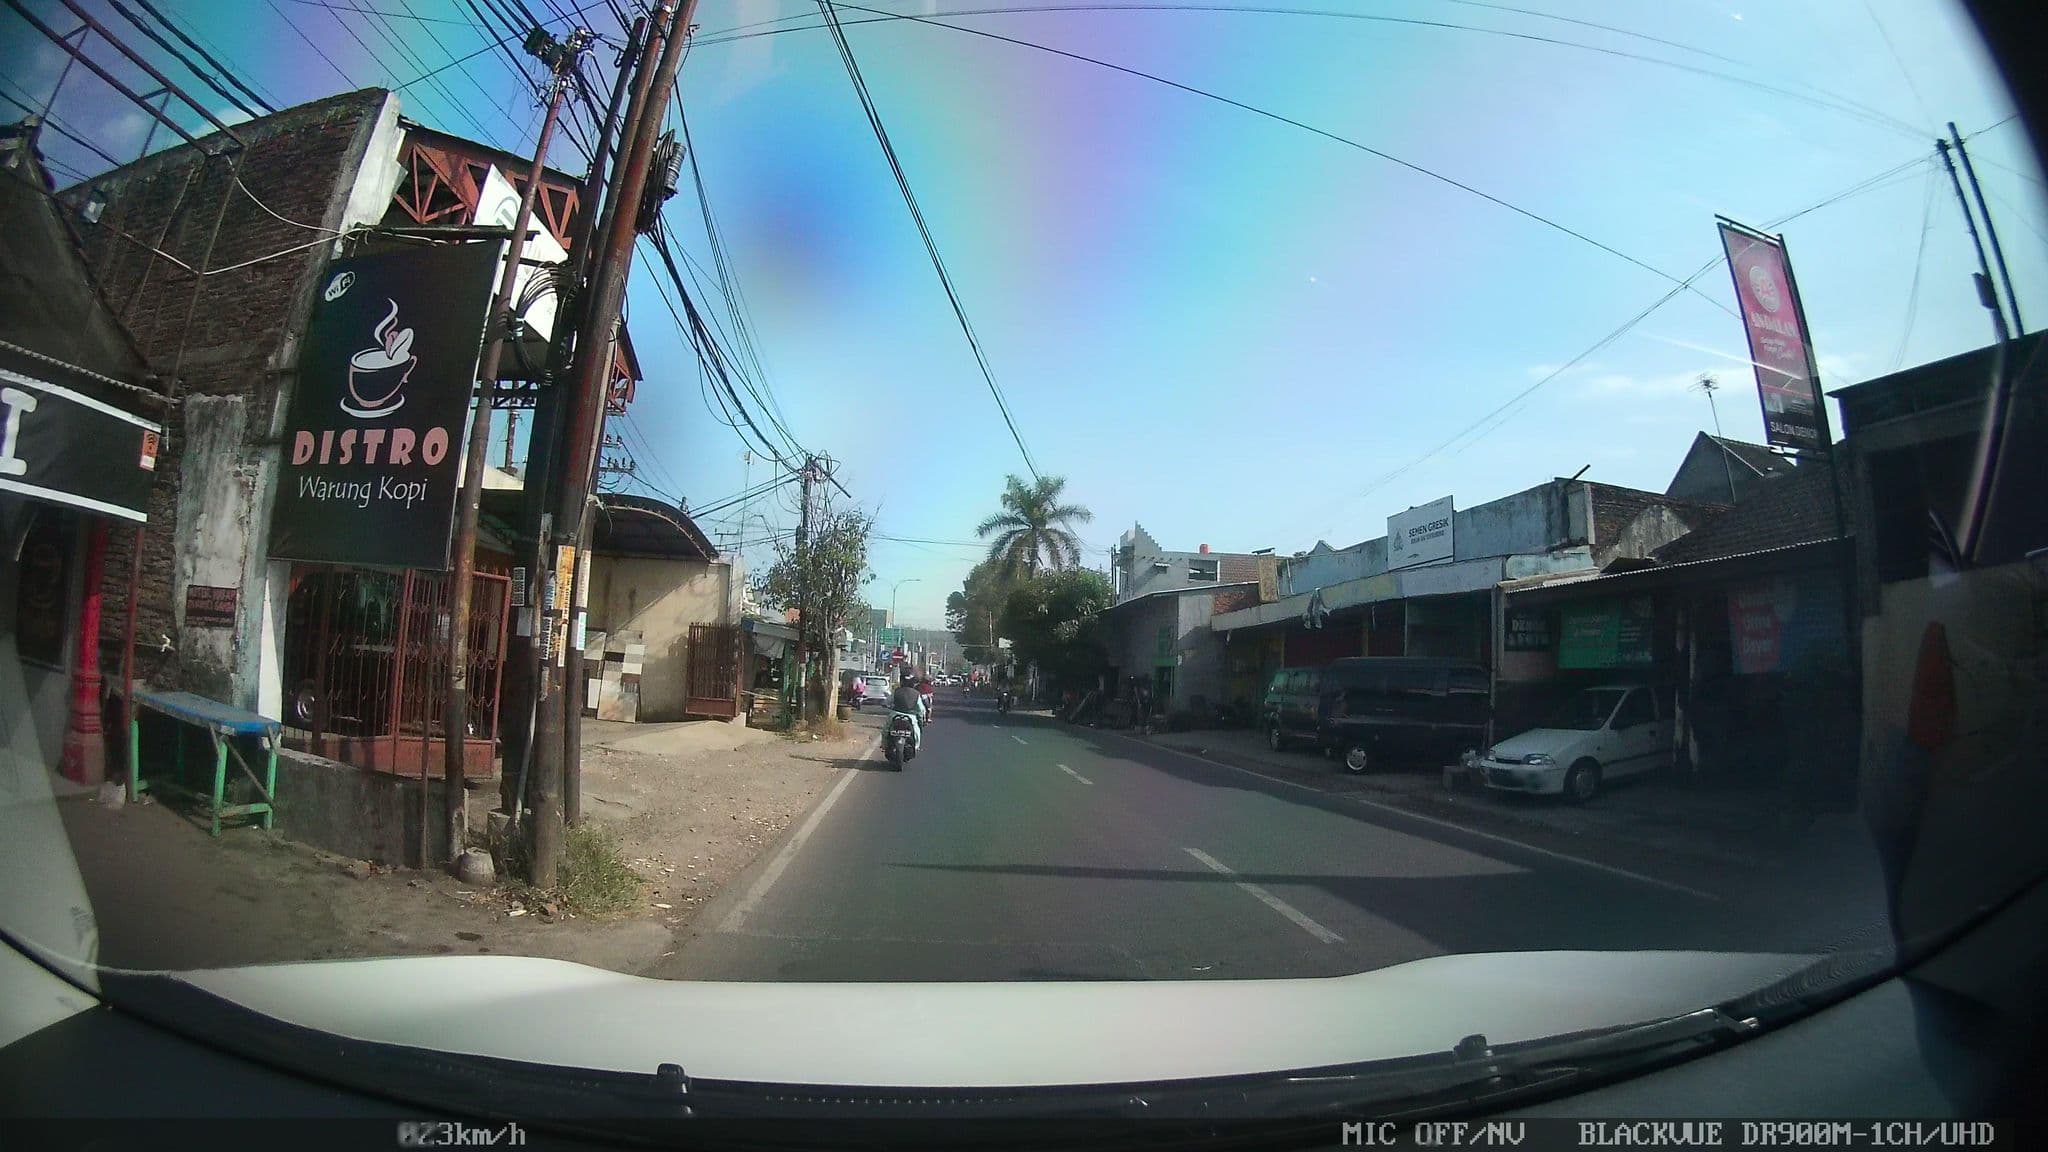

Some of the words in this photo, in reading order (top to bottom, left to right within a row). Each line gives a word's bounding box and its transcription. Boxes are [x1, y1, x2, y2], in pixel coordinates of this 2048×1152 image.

[292, 426, 449, 466] DISTRO
[299, 475, 372, 509] Warung
[378, 475, 428, 509] Kopi
